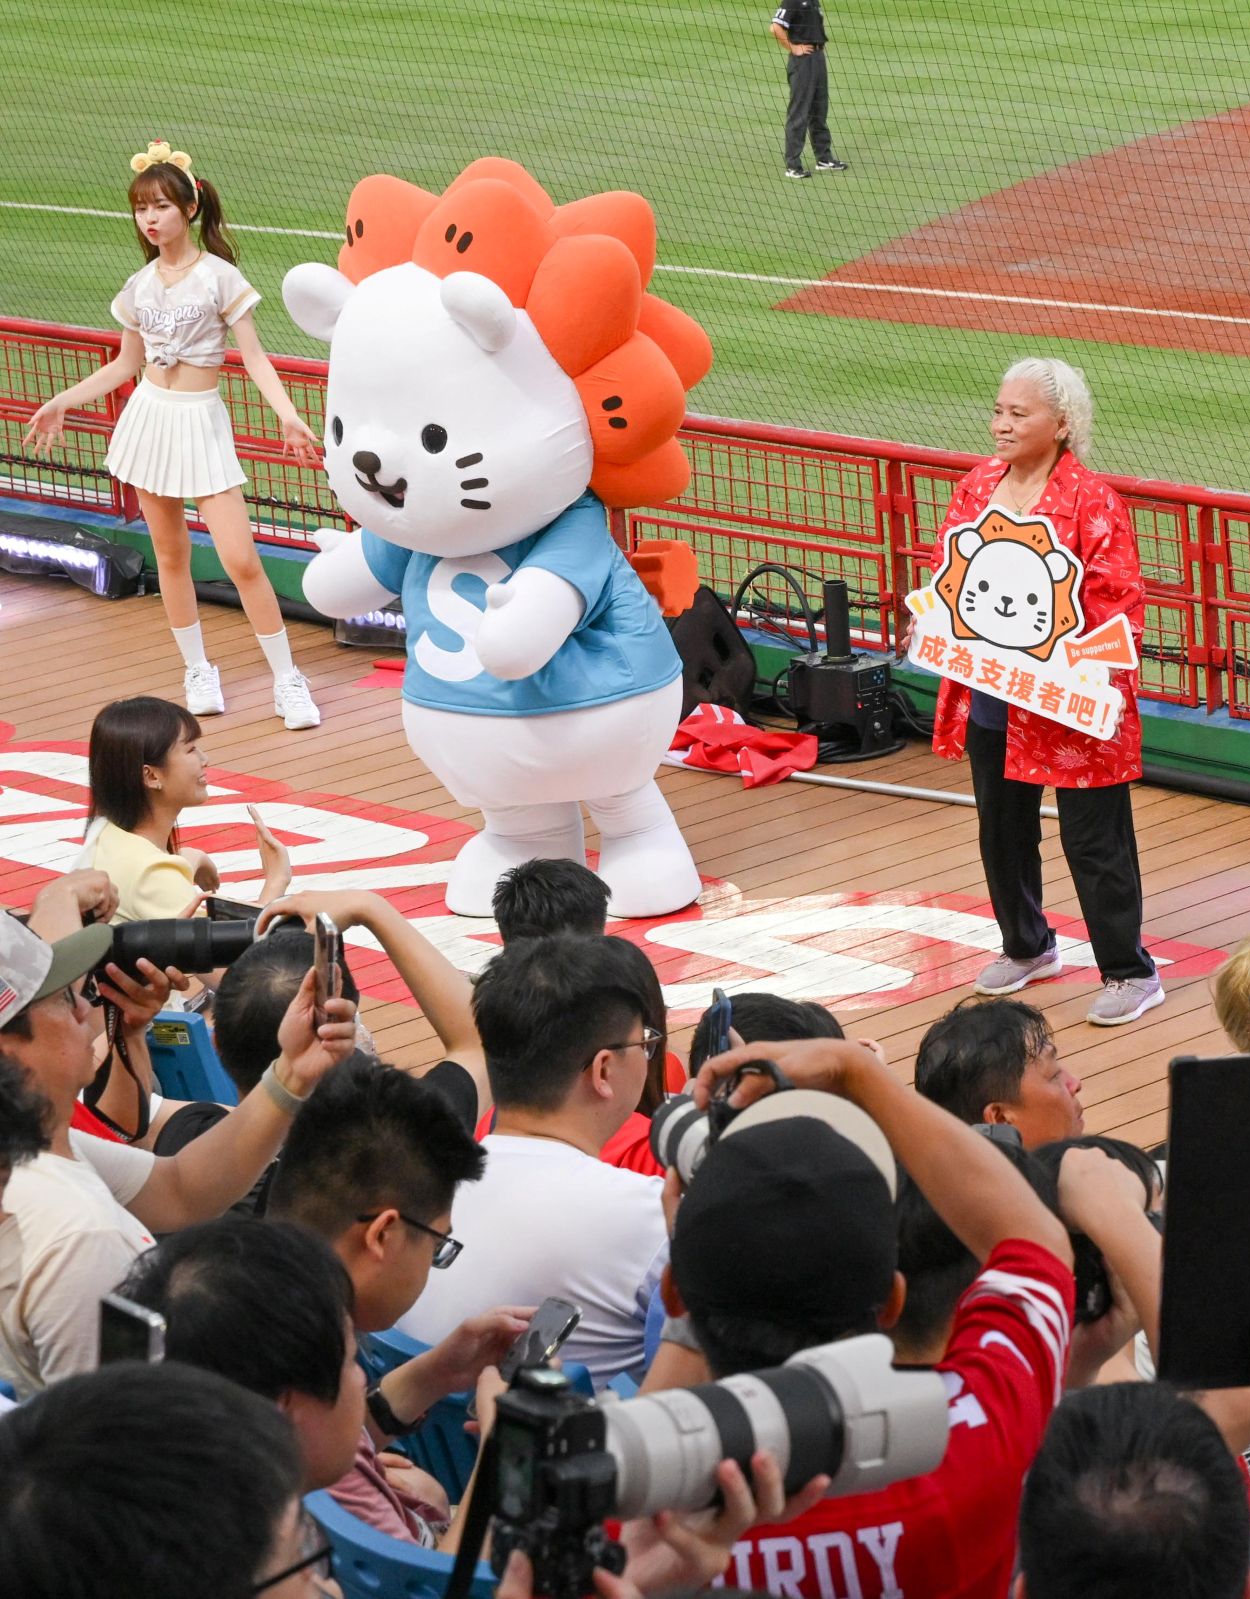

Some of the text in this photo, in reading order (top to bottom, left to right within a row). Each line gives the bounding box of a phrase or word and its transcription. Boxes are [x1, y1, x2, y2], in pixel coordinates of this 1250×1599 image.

[140, 304, 205, 335] Dragons
[414, 552, 513, 682] S
[1070, 639, 1122, 658] Be supporters!
[917, 633, 1111, 734] 成為支援者吧!
